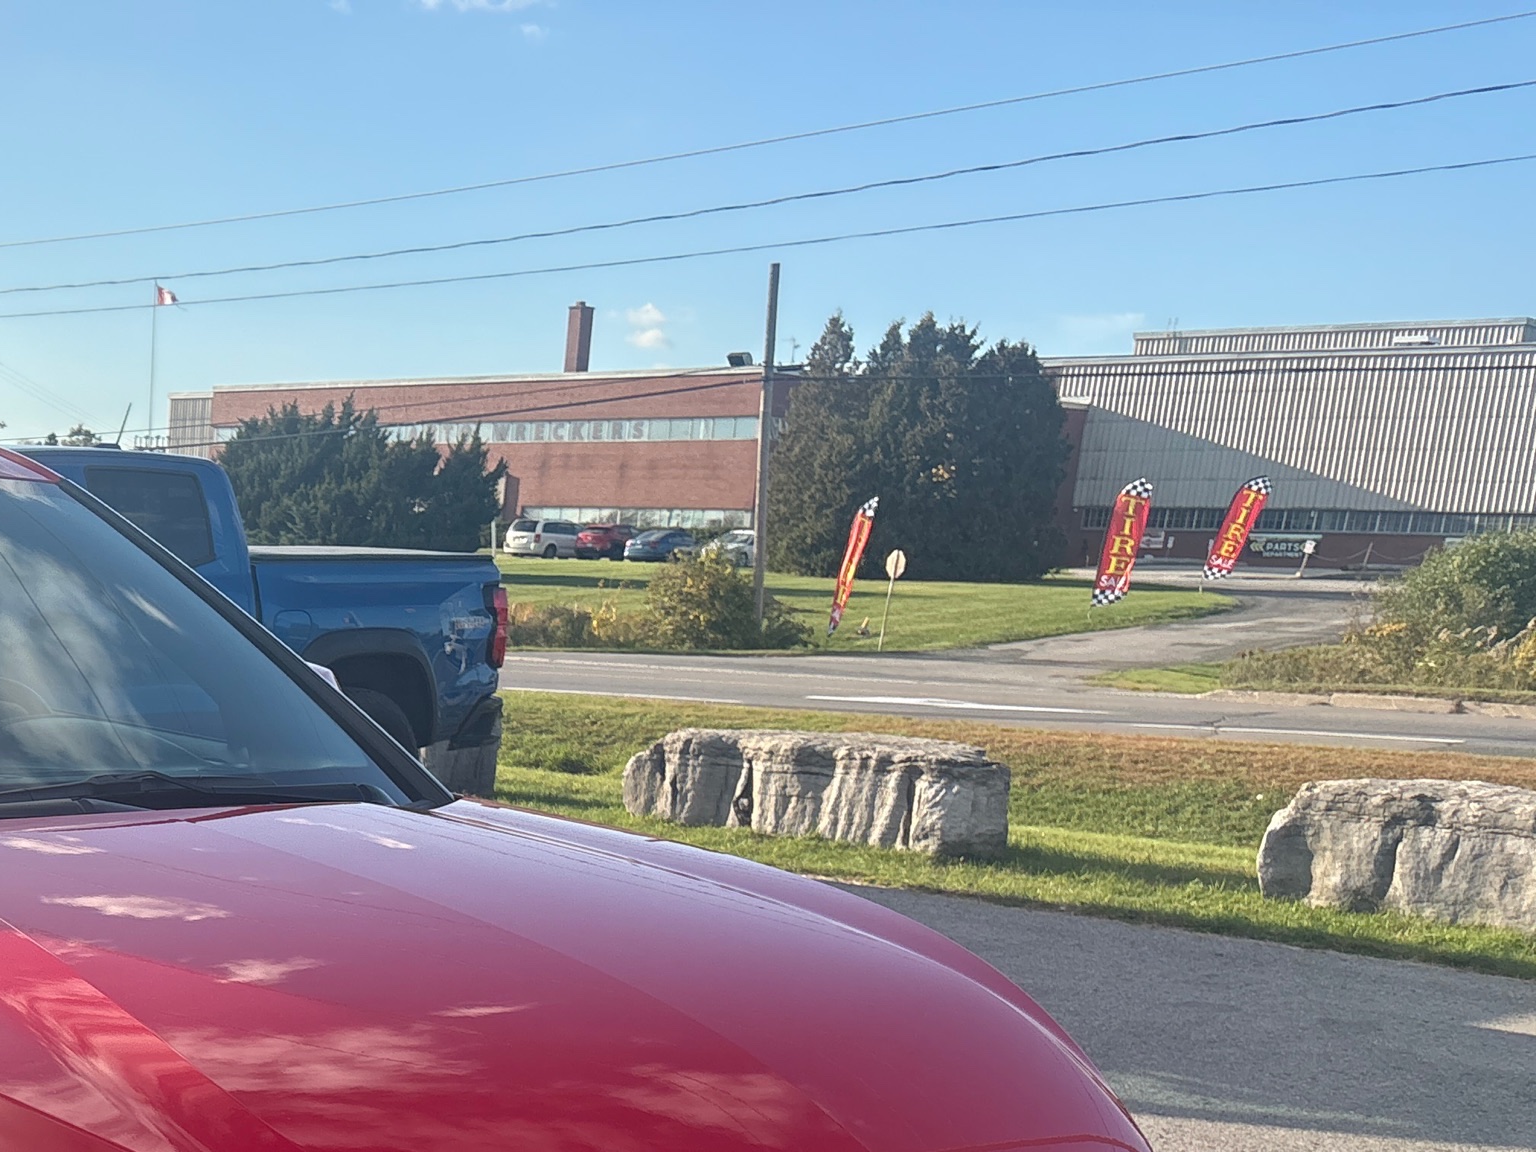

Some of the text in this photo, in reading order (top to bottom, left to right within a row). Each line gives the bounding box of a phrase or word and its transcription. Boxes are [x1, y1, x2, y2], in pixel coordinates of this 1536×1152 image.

[491, 420, 648, 441] WRECKERS
[1218, 490, 1264, 559] TIRE
[1105, 496, 1146, 575] TIRE
[1265, 541, 1300, 552] PARTS
[1209, 554, 1236, 569] SALE
